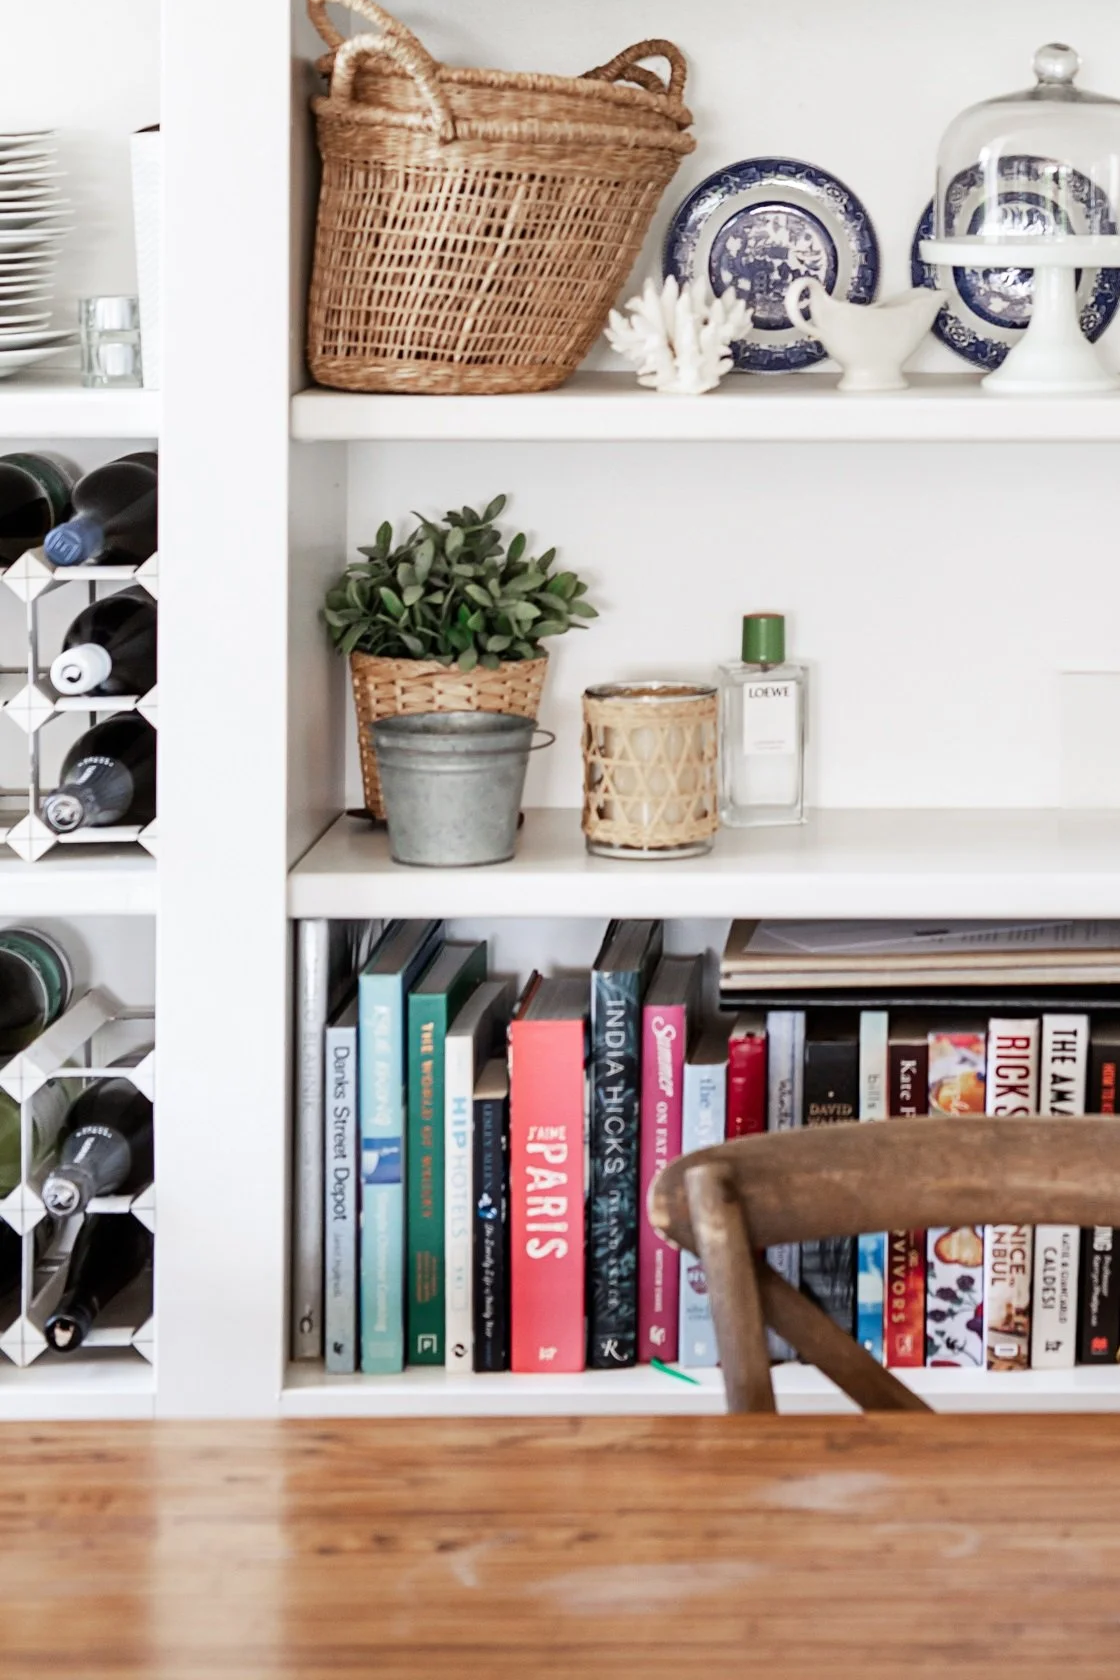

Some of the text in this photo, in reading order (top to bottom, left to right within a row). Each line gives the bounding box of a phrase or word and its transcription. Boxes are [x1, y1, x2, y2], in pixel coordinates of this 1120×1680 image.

[748, 686, 790, 699] LOEWE
[605, 1000, 626, 1075] INDIA
[651, 1016, 676, 1097] Summer
[1051, 1029, 1078, 1064] THE
[700, 1078, 716, 1108] the
[868, 1073, 881, 1110] bills
[900, 1059, 917, 1100] Kate
[995, 1036, 1030, 1100] RICK
[331, 1046, 350, 1221] Danks Street Depot
[421, 1022, 434, 1218] THE WORLD OF WHISKY
[452, 1096, 467, 1149] HIP
[527, 1124, 567, 1141] J'AIME
[603, 1086, 626, 1177] HICKS
[655, 1101, 668, 1124] ON
[809, 1103, 853, 1116] DAVID
[655, 1128, 668, 1154] FAT
[452, 1154, 467, 1238] HOTELS
[525, 1142, 568, 1260] PARIS
[991, 1231, 1008, 1286] NBUL
[1010, 1225, 1027, 1275] NICE
[1042, 1246, 1057, 1310] CALDESI
